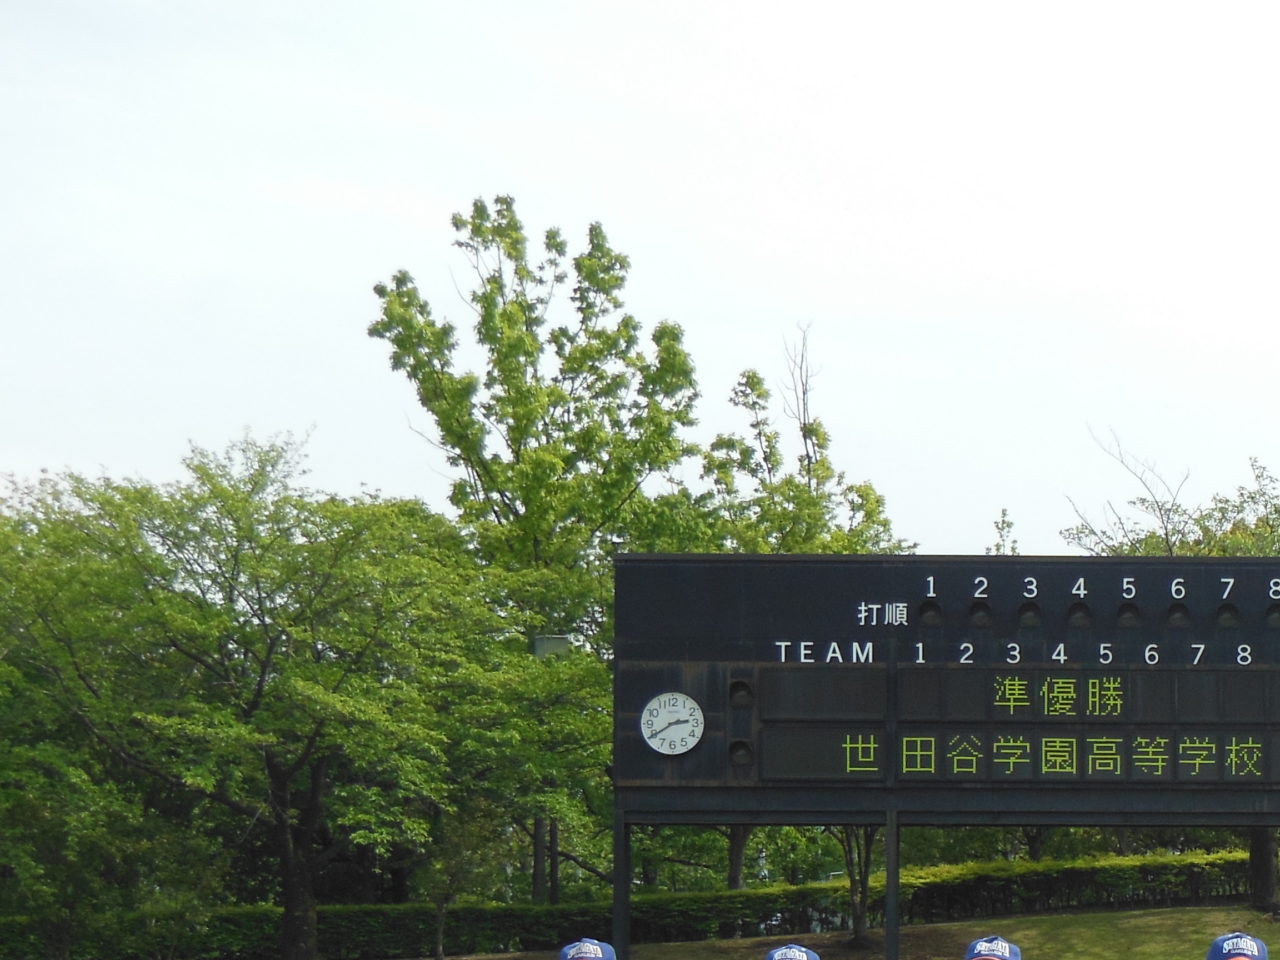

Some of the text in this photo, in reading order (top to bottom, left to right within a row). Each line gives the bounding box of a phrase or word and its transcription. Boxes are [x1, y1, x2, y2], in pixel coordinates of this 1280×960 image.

[926, 575, 937, 598] 1
[973, 576, 988, 598] 2
[1023, 576, 1038, 598] 3
[1071, 577, 1088, 599] 4
[1122, 577, 1136, 599] 5
[1171, 578, 1186, 599] 6
[1220, 578, 1235, 600] 7
[857, 601, 908, 626] 打順
[775, 641, 873, 664] TEAM
[915, 642, 926, 664] 1
[959, 642, 974, 664] 2
[1006, 642, 1021, 664] 3
[1051, 643, 1068, 664] 4
[1099, 643, 1113, 665] 5
[1144, 643, 1159, 665] 6
[1191, 644, 1205, 665] 7
[1236, 644, 1252, 666] 8
[993, 676, 1124, 716] 準優勝
[668, 697, 678, 707] 12
[683, 700, 686, 709] 1
[647, 708, 659, 718] 10
[689, 707, 696, 716] 2
[646, 719, 654, 729] 9
[692, 719, 699, 728] 3
[688, 730, 696, 738] 4
[659, 737, 666, 747] 7
[668, 740, 677, 750] 6
[680, 737, 688, 747] 5
[842, 735, 1262, 775] 世田谷学園高等学校
